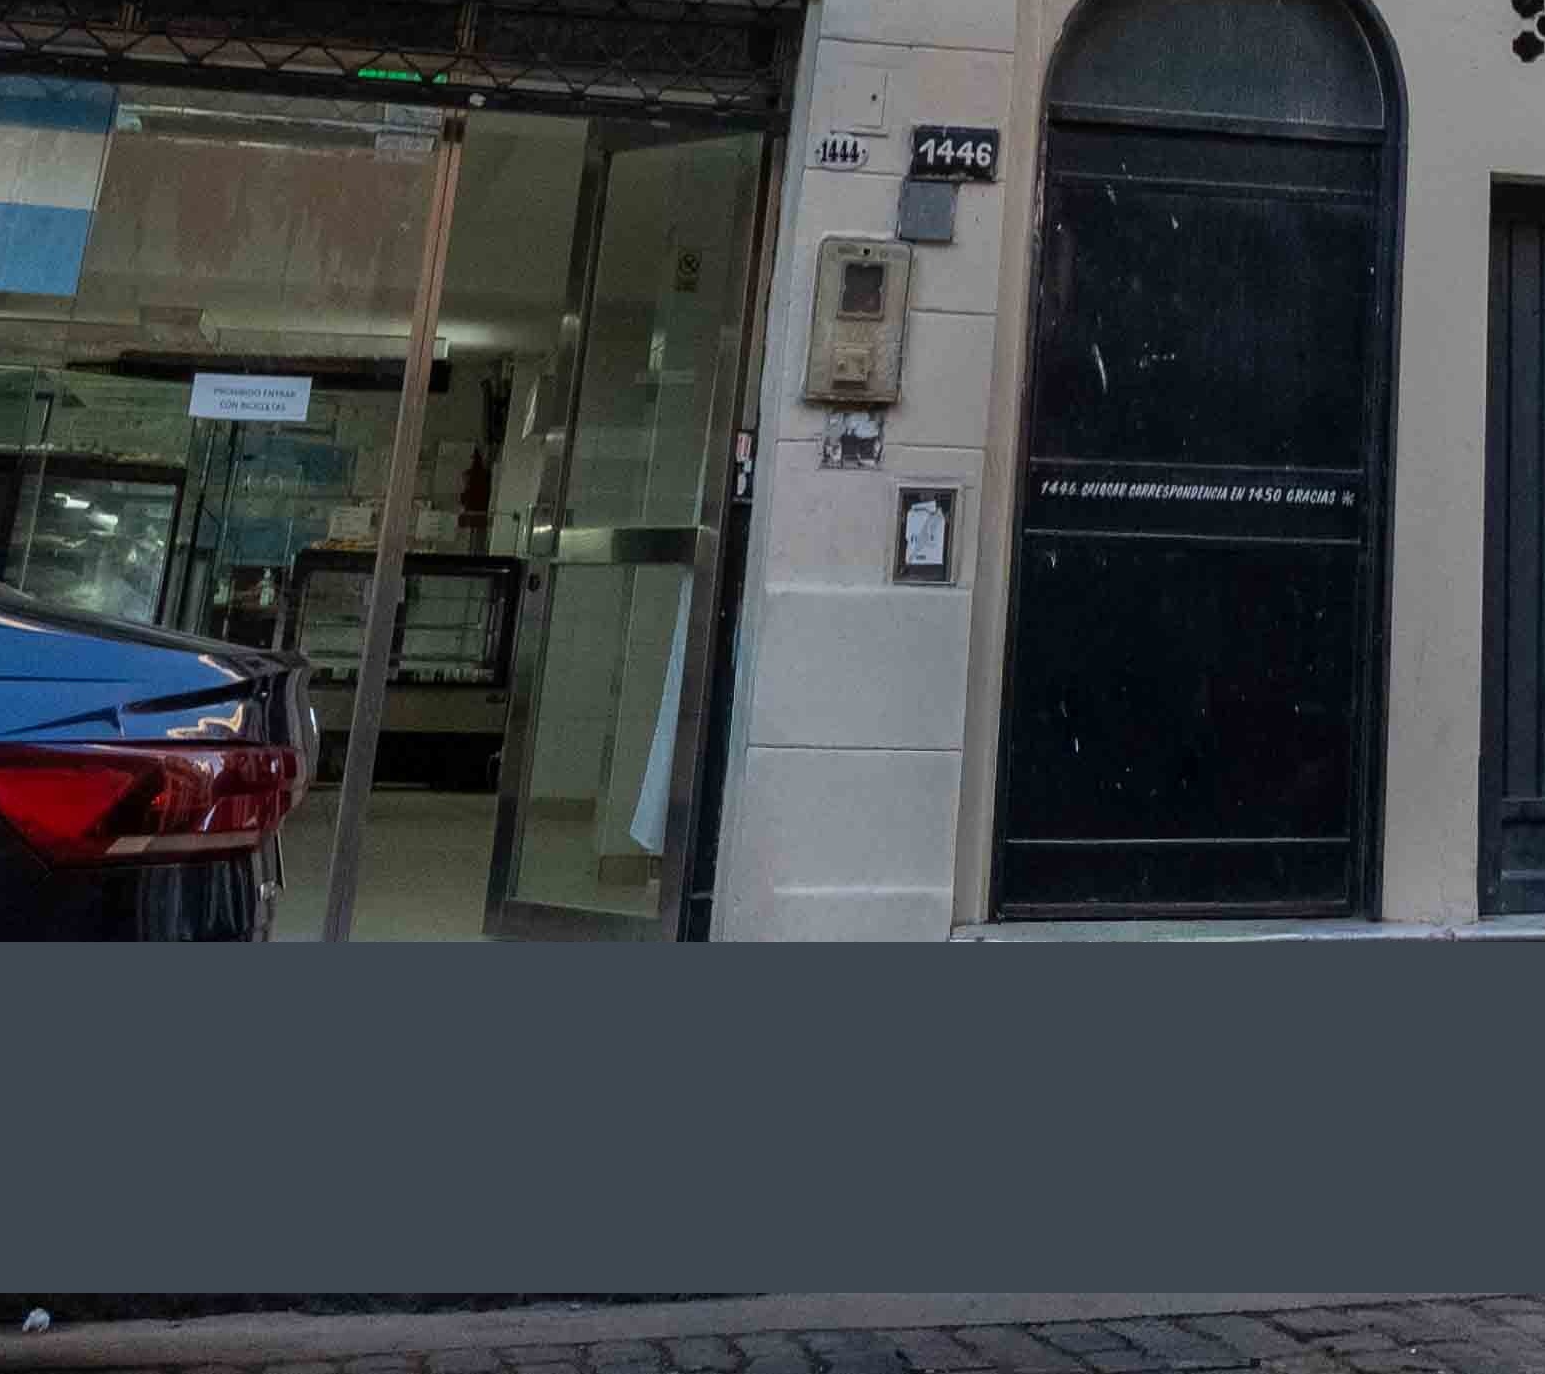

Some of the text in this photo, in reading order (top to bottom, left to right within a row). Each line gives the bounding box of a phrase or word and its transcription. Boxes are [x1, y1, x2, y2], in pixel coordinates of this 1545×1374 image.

[820, 139, 861, 164] 1444
[918, 138, 993, 167] 1446
[1128, 484, 1227, 500] CORRESPONDENCIA
[1230, 487, 1246, 501] EN
[1248, 487, 1282, 502] 1450
[1286, 489, 1336, 505] GRACIAS
